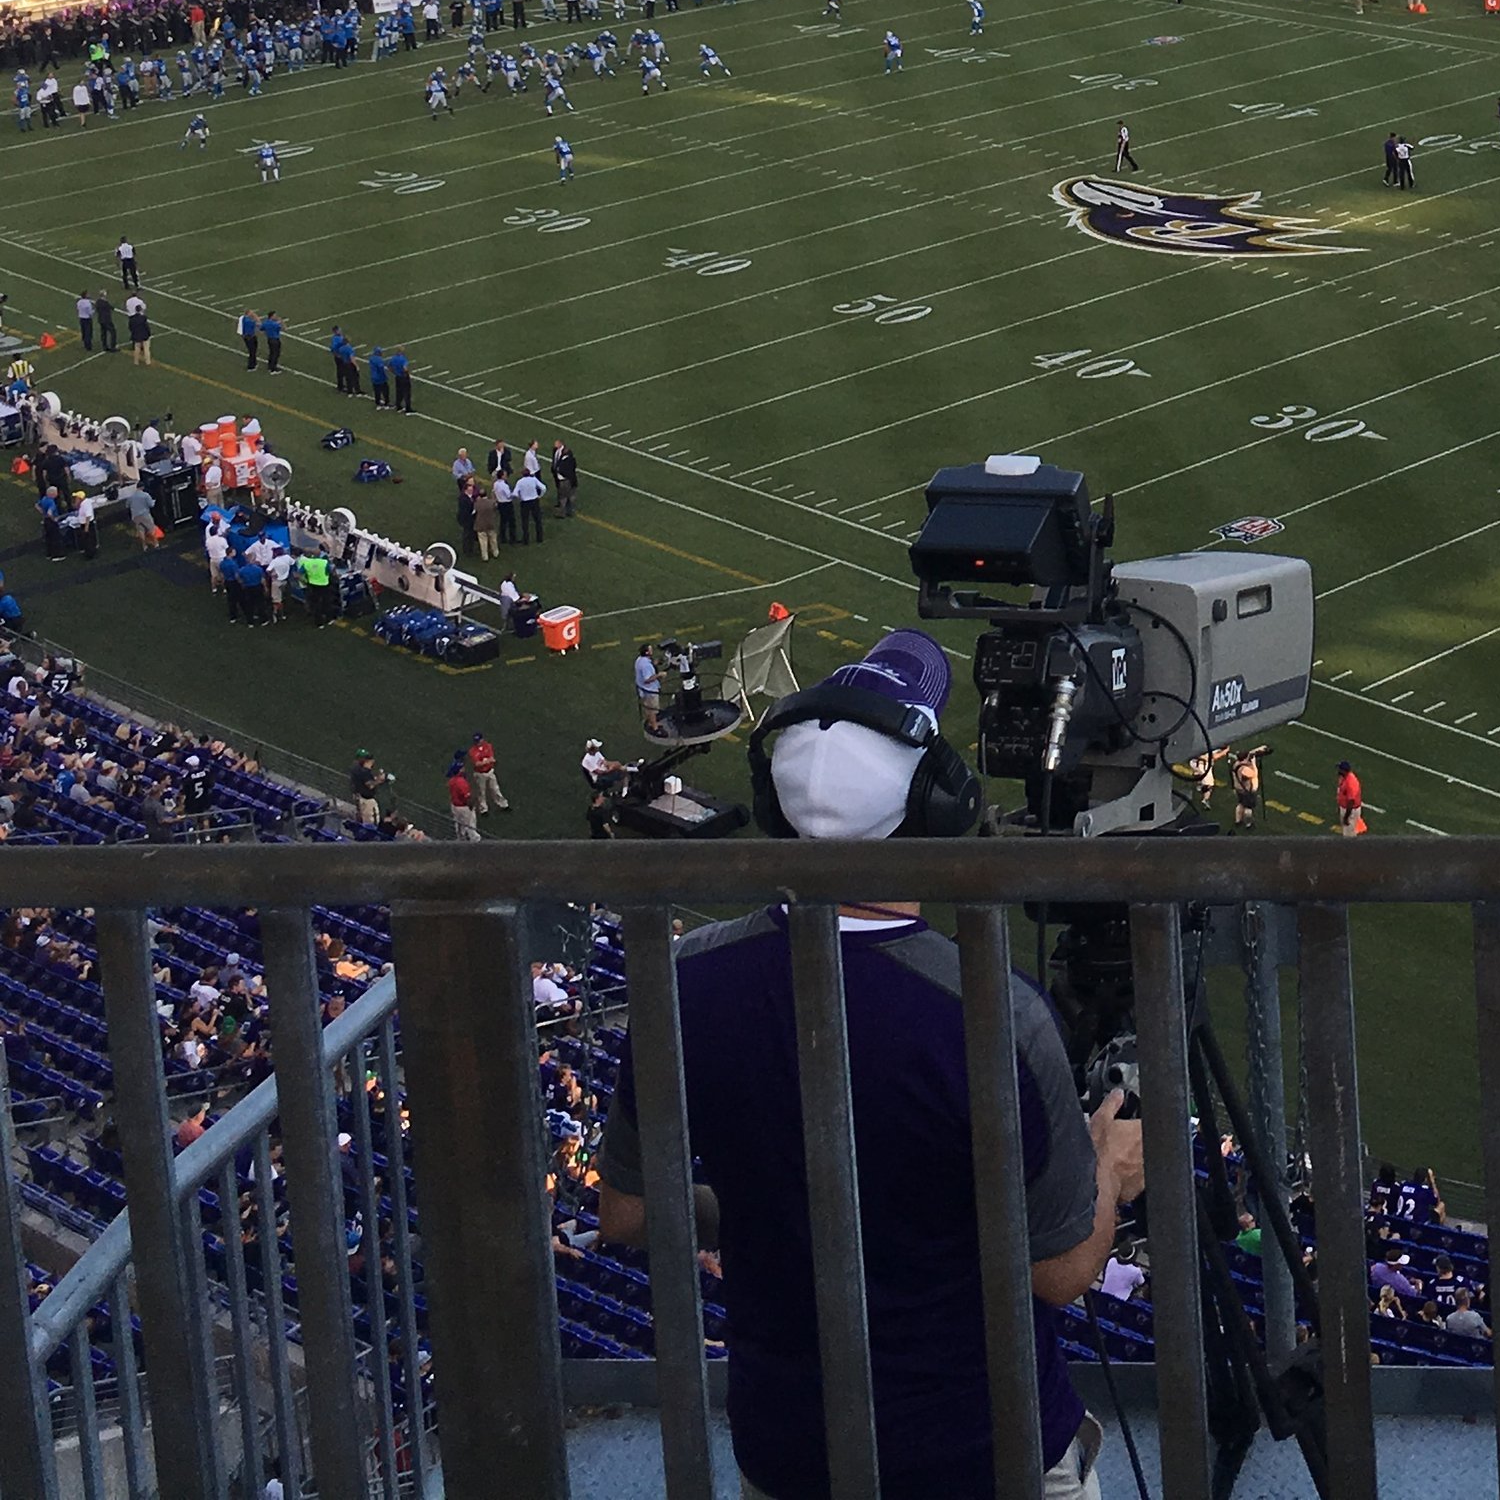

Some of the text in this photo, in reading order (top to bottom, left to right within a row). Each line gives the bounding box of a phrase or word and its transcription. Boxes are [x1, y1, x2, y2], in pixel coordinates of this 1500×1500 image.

[503, 207, 591, 233] 30
[663, 247, 752, 277] 40
[832, 294, 933, 325] 50
[1031, 348, 1135, 380] 40
[1249, 404, 1367, 443] 30
[562, 622, 577, 641] G
[51, 679, 70, 694] 57
